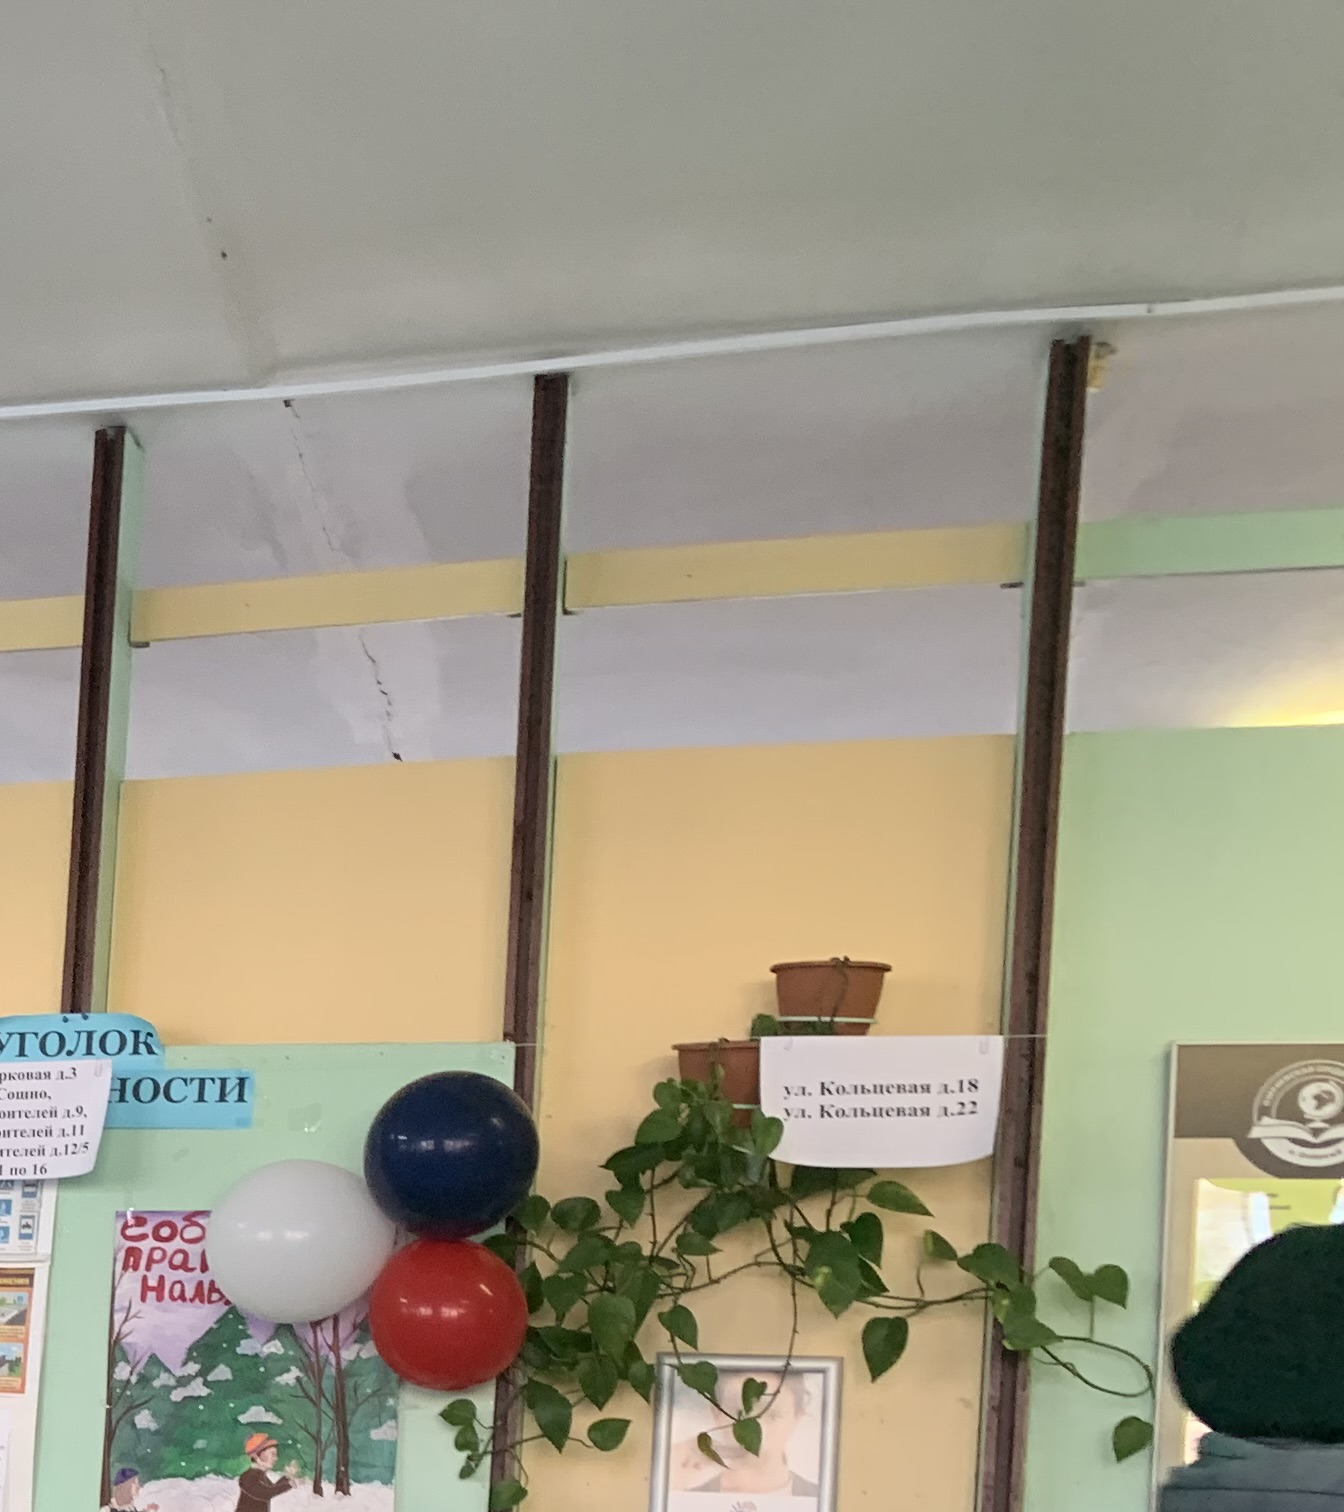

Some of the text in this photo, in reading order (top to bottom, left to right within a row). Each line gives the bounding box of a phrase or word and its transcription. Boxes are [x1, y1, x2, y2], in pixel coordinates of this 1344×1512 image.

[55, 1066, 77, 1081] д.3
[783, 1078, 979, 1100] ул. Кольцевая д.18
[783, 1101, 978, 1121] ул. Кольцевая д.22
[57, 1124, 84, 1139] д.11
[49, 1141, 89, 1157] д.12/5
[9, 1166, 26, 1176] по
[33, 1163, 48, 1175] 16
